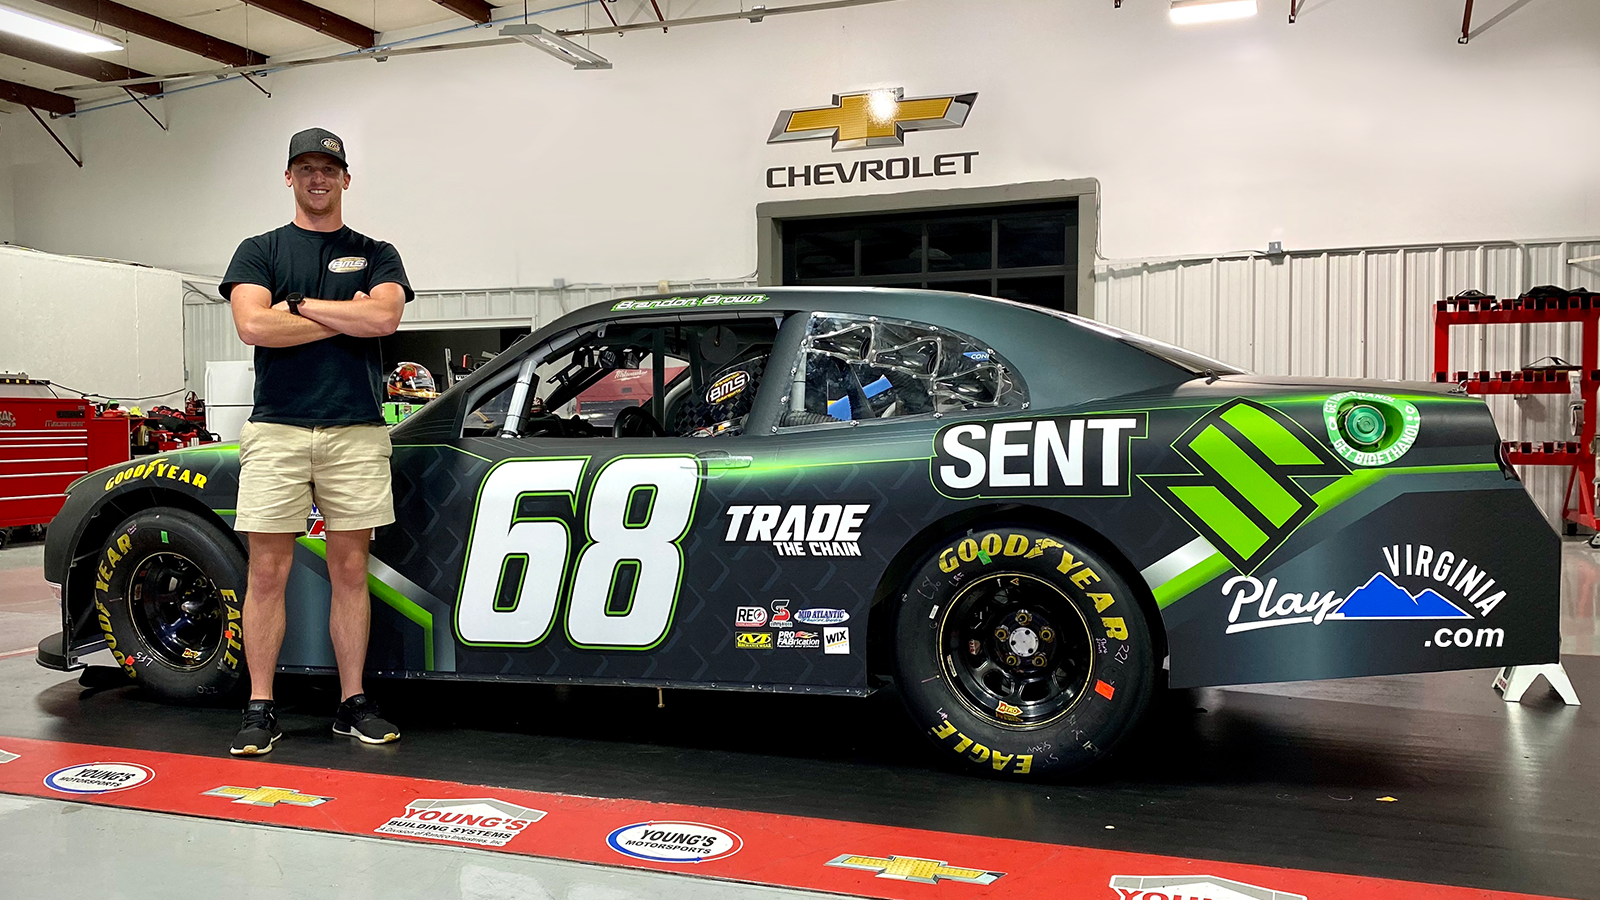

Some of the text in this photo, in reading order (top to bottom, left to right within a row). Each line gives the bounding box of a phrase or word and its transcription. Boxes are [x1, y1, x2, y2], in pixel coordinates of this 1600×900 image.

[767, 152, 979, 188] CHEVROLET
[614, 294, 768, 310] Brandon Brown
[939, 418, 1137, 489] SENT
[1334, 439, 1356, 457] GET
[104, 459, 208, 491] GOODYEAR
[724, 504, 871, 542] TRADE
[456, 455, 700, 649] 68
[772, 541, 862, 557] THE CHAIN
[1382, 544, 1508, 618] VIRGINIA
[1221, 575, 1345, 627] Play
[798, 610, 845, 619] MID ATLANTIC
[219, 588, 244, 670] EAGLE
[778, 630, 796, 639] PRO
[825, 630, 847, 644] WIX
[1423, 626, 1505, 648] .com
[930, 719, 1034, 774] EAGLE
[59, 776, 122, 787] MOTORSPORTS
[75, 769, 135, 781] YOUNG'S
[387, 820, 512, 839] BUILDING SYSTEMS
[404, 808, 528, 831] YOUNG'S
[625, 839, 712, 855] MOTORSPORTS
[640, 829, 718, 847] YOUNG'S
